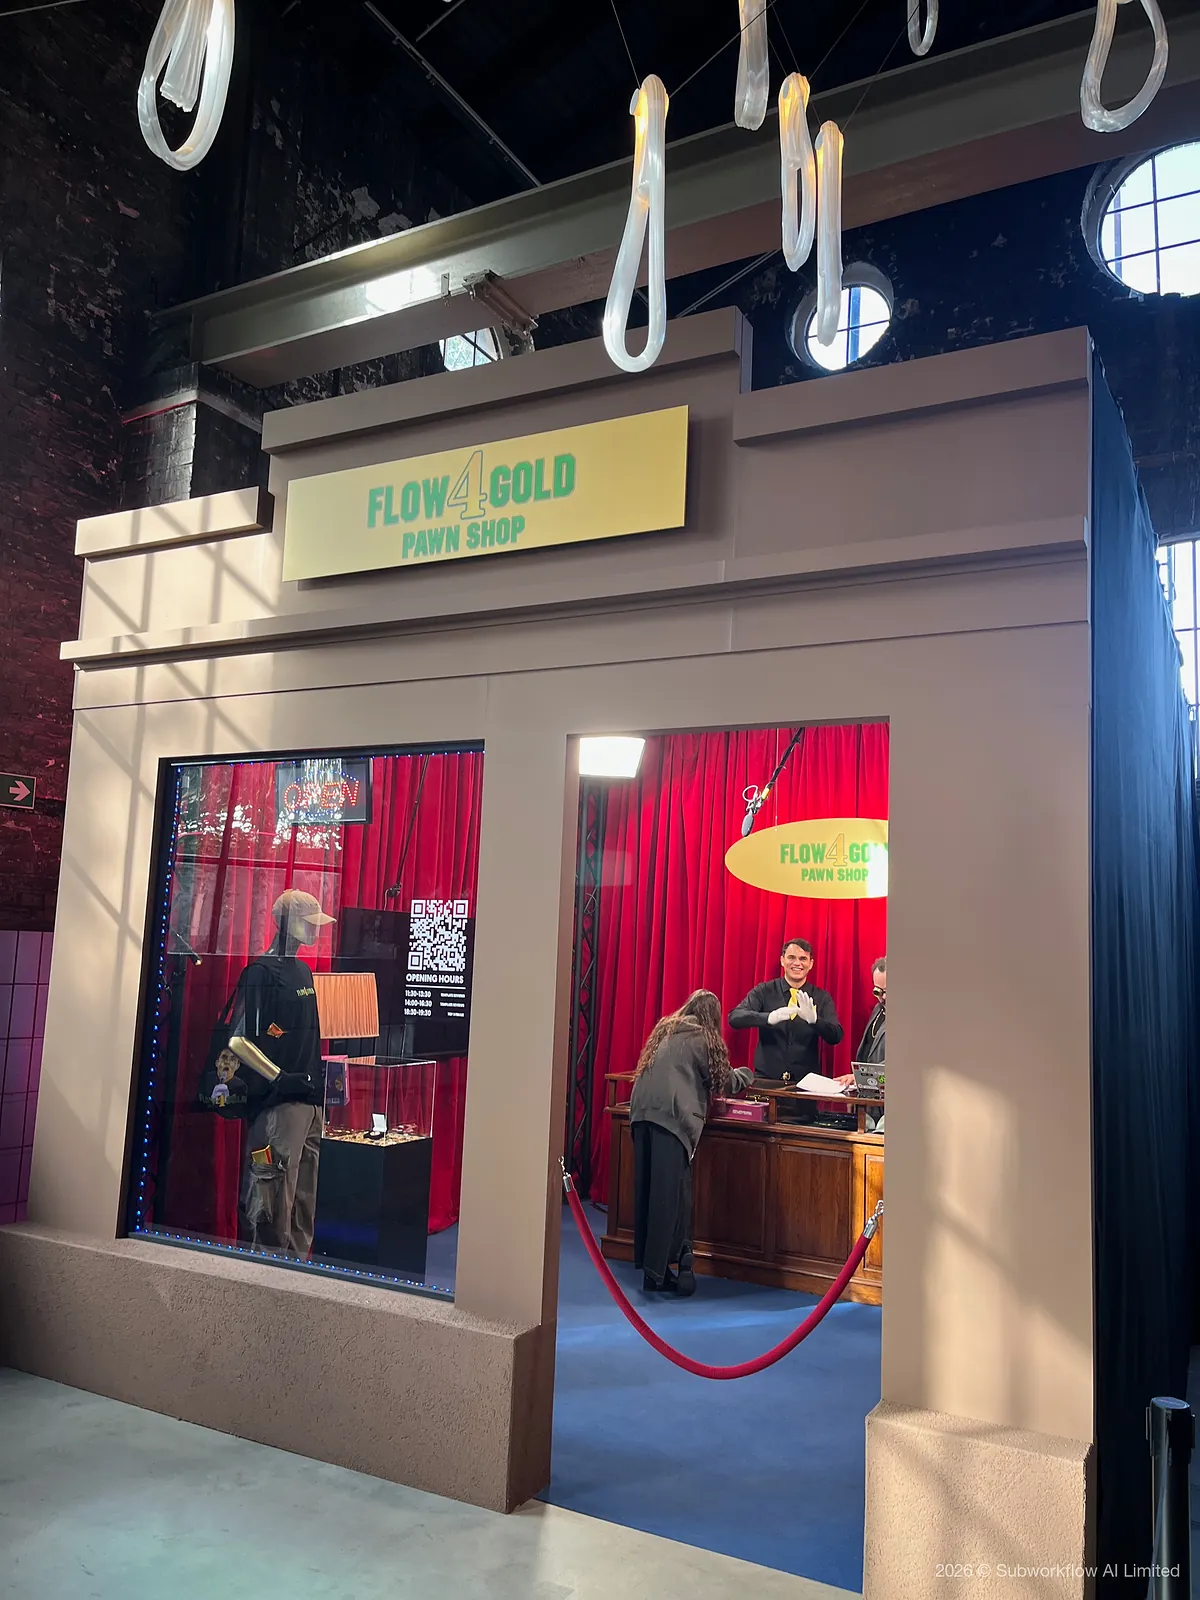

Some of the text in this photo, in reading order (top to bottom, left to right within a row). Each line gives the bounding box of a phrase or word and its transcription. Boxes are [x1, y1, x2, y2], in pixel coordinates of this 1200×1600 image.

[367, 450, 576, 528] FLOW4GOLD
[402, 515, 525, 559] PAWN SHOP
[283, 780, 360, 811] OPEN
[801, 868, 869, 882] PAWN SHOP
[405, 973, 464, 984] OPENING HOURS
